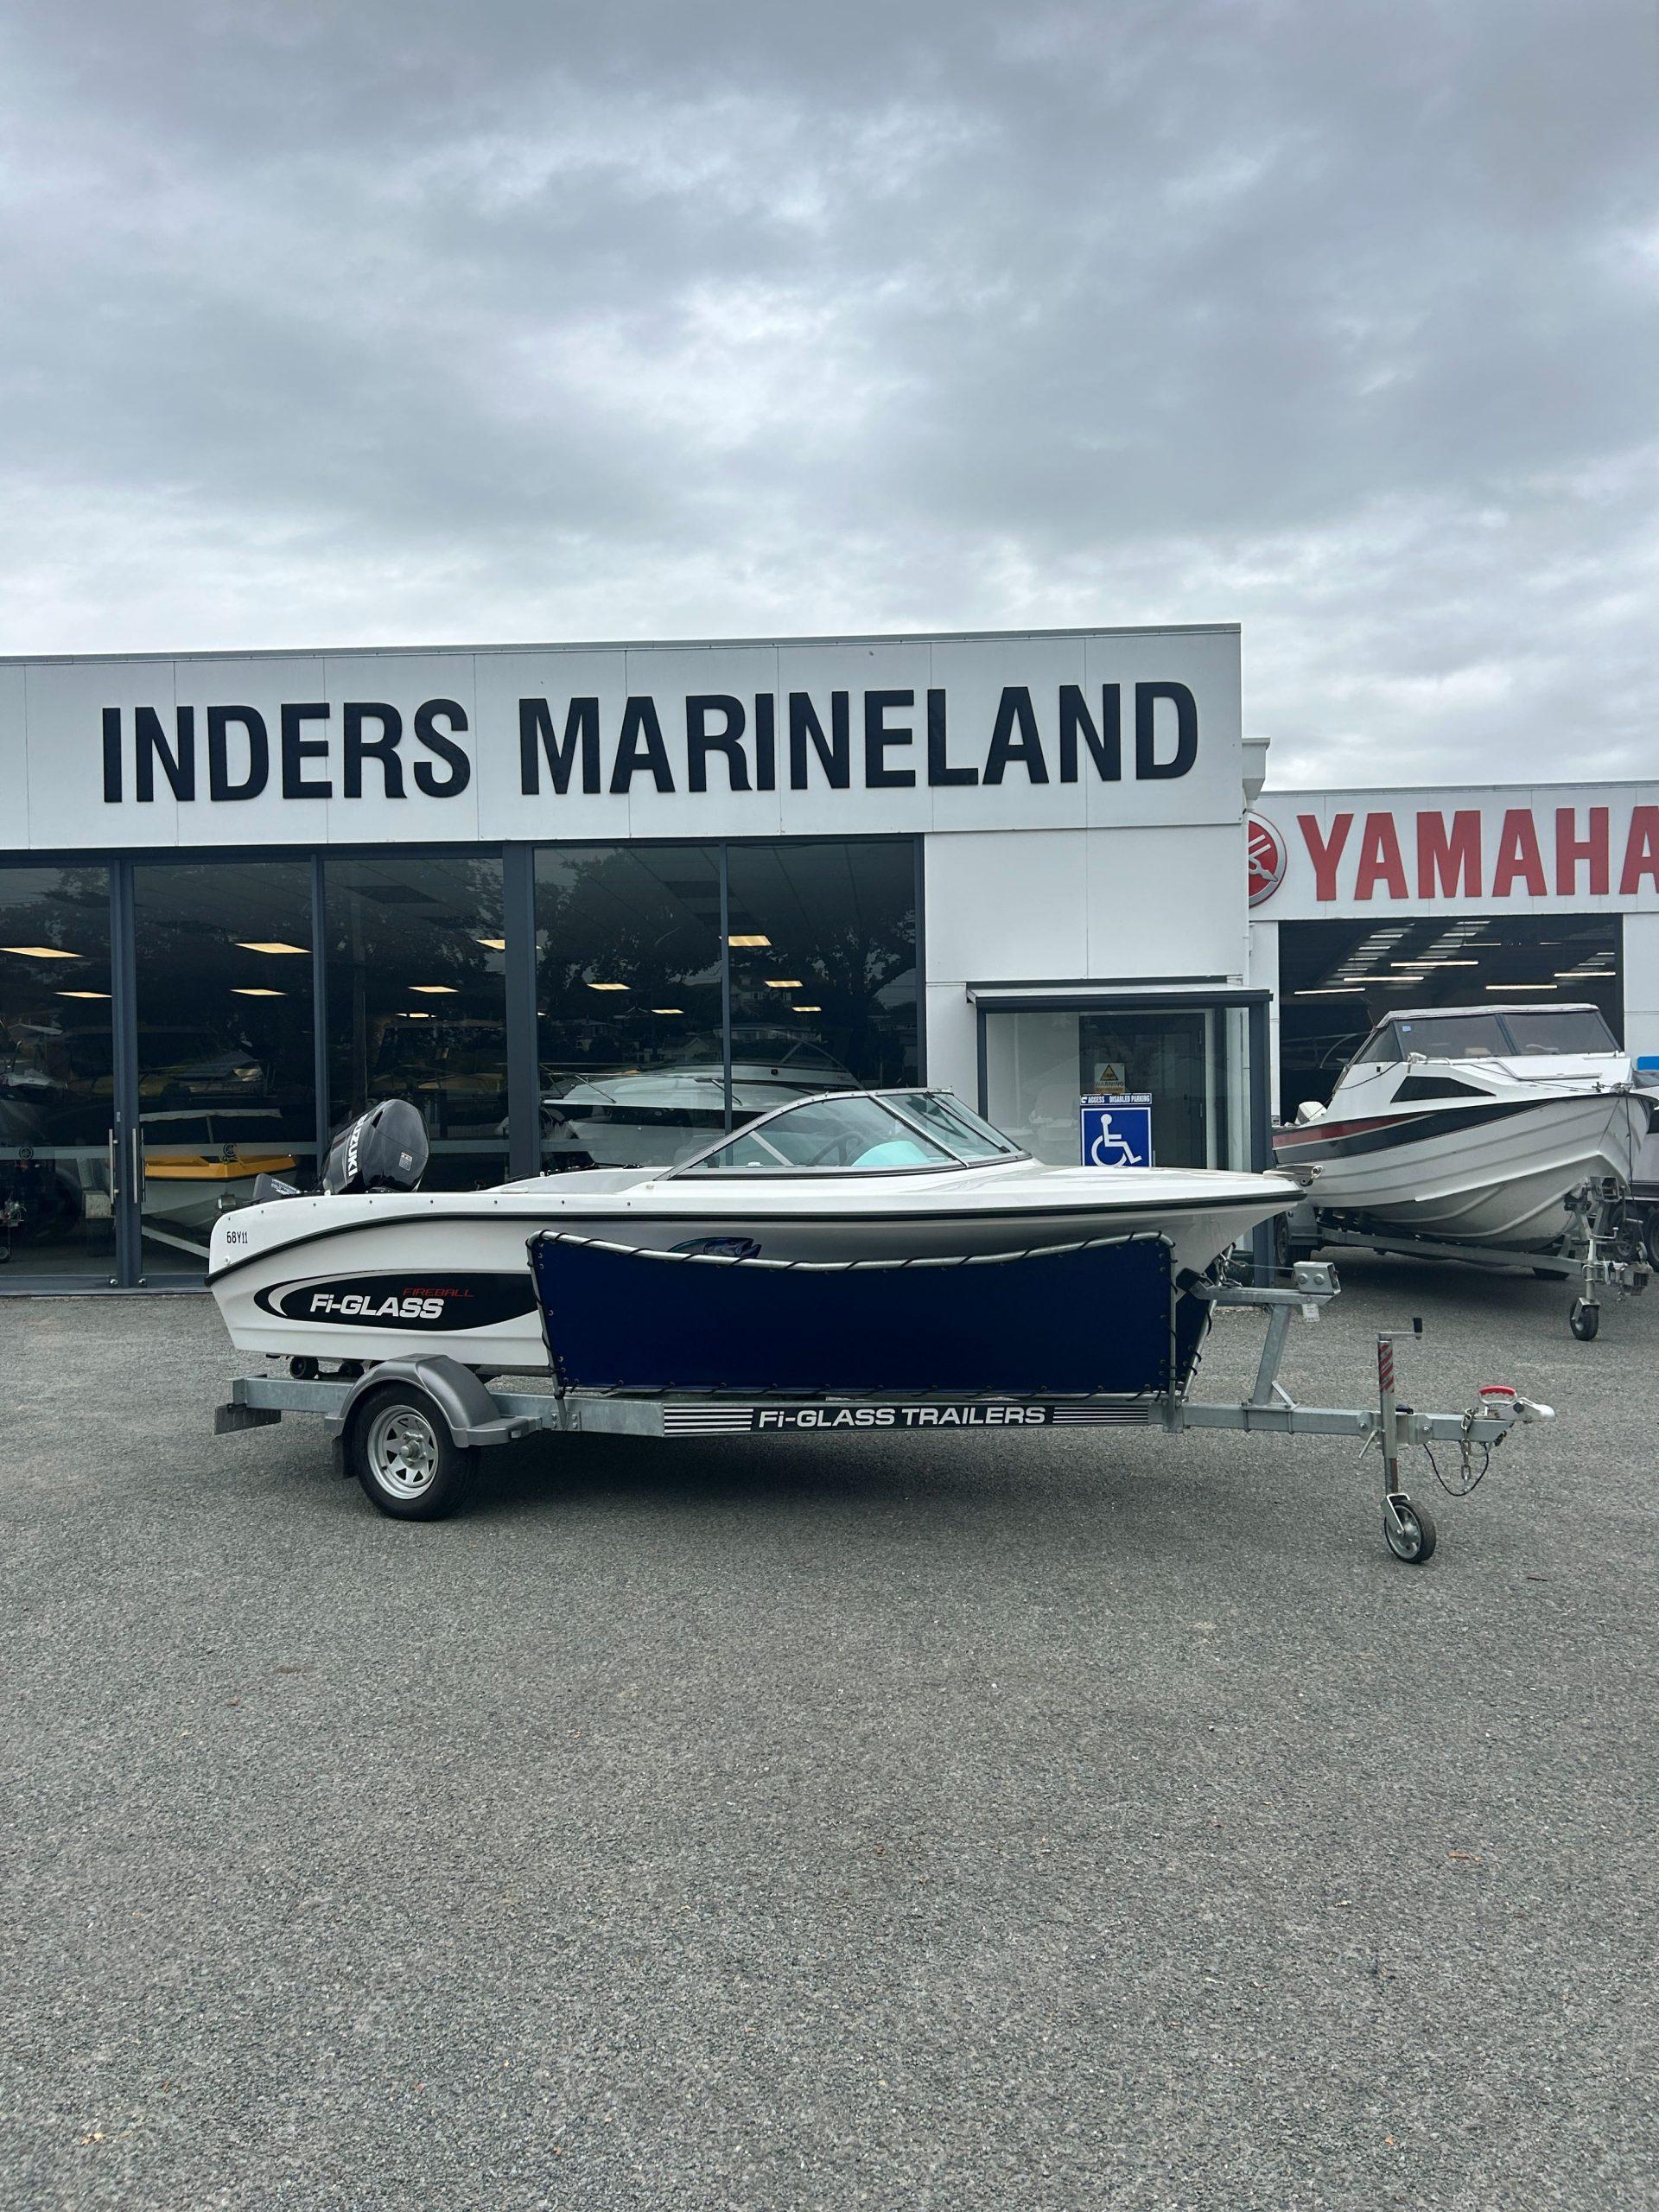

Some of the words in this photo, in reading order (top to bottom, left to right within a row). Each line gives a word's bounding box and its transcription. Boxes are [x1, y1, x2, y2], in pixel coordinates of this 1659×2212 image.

[102, 698, 471, 803] INDERS
[519, 683, 1198, 795] MARINELAND
[1297, 805, 1659, 901] YAMAHA
[1109, 1095, 1130, 1103] DISABLED
[348, 1113, 369, 1177] SUZUKI
[226, 1230, 248, 1244] 68Y11
[403, 1287, 474, 1297] FIREBALL
[309, 1294, 445, 1319] Fi-GLASS
[759, 1408, 895, 1428] Fi-GLASS
[902, 1407, 1046, 1426] TRAILERS
